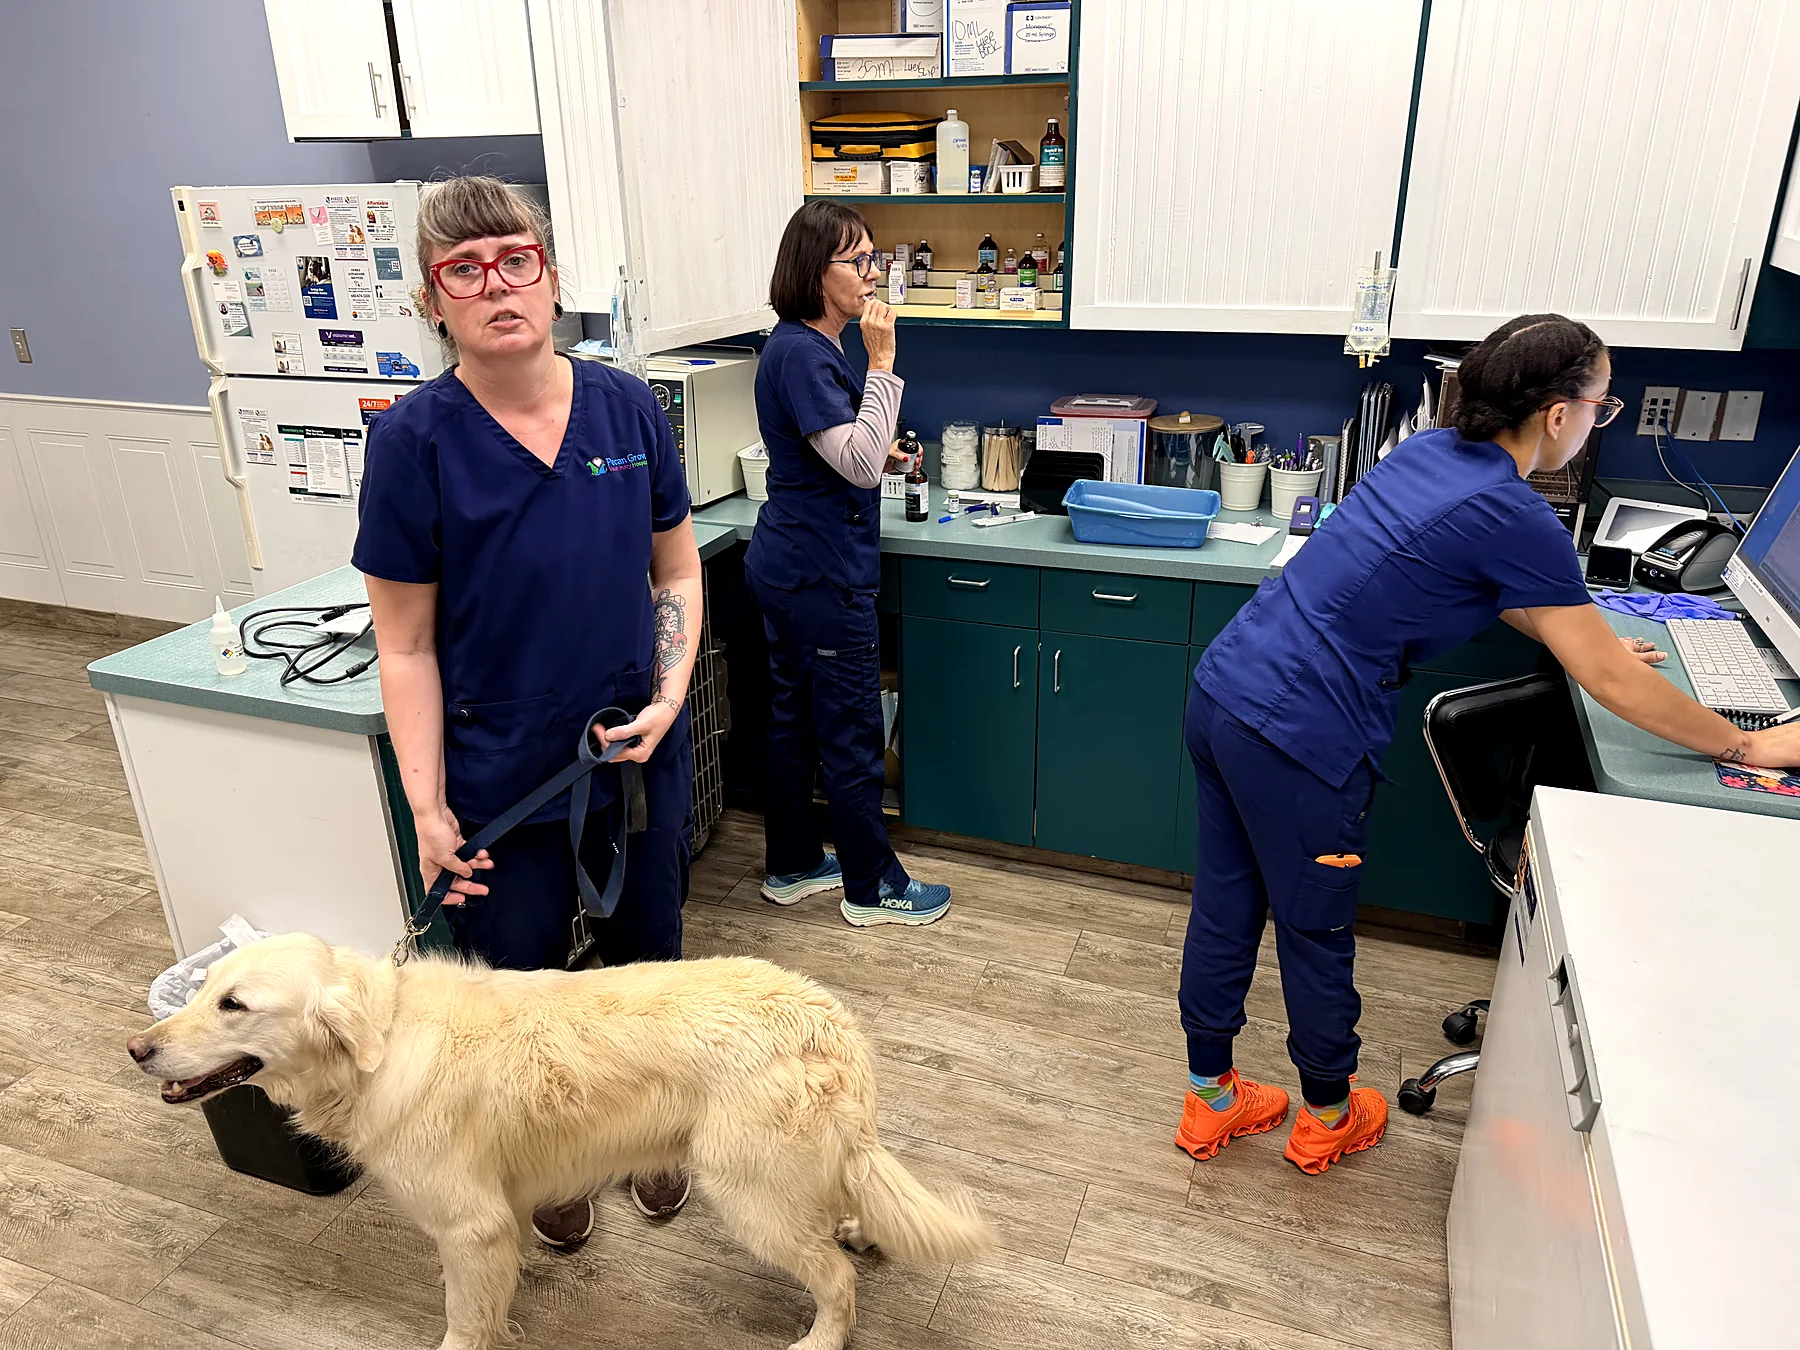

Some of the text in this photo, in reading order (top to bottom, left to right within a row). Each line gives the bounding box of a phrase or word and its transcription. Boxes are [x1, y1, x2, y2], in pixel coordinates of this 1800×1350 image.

[362, 400, 377, 408] 24/7
[605, 457, 628, 466] Pecan
[879, 898, 913, 910] HOKA
